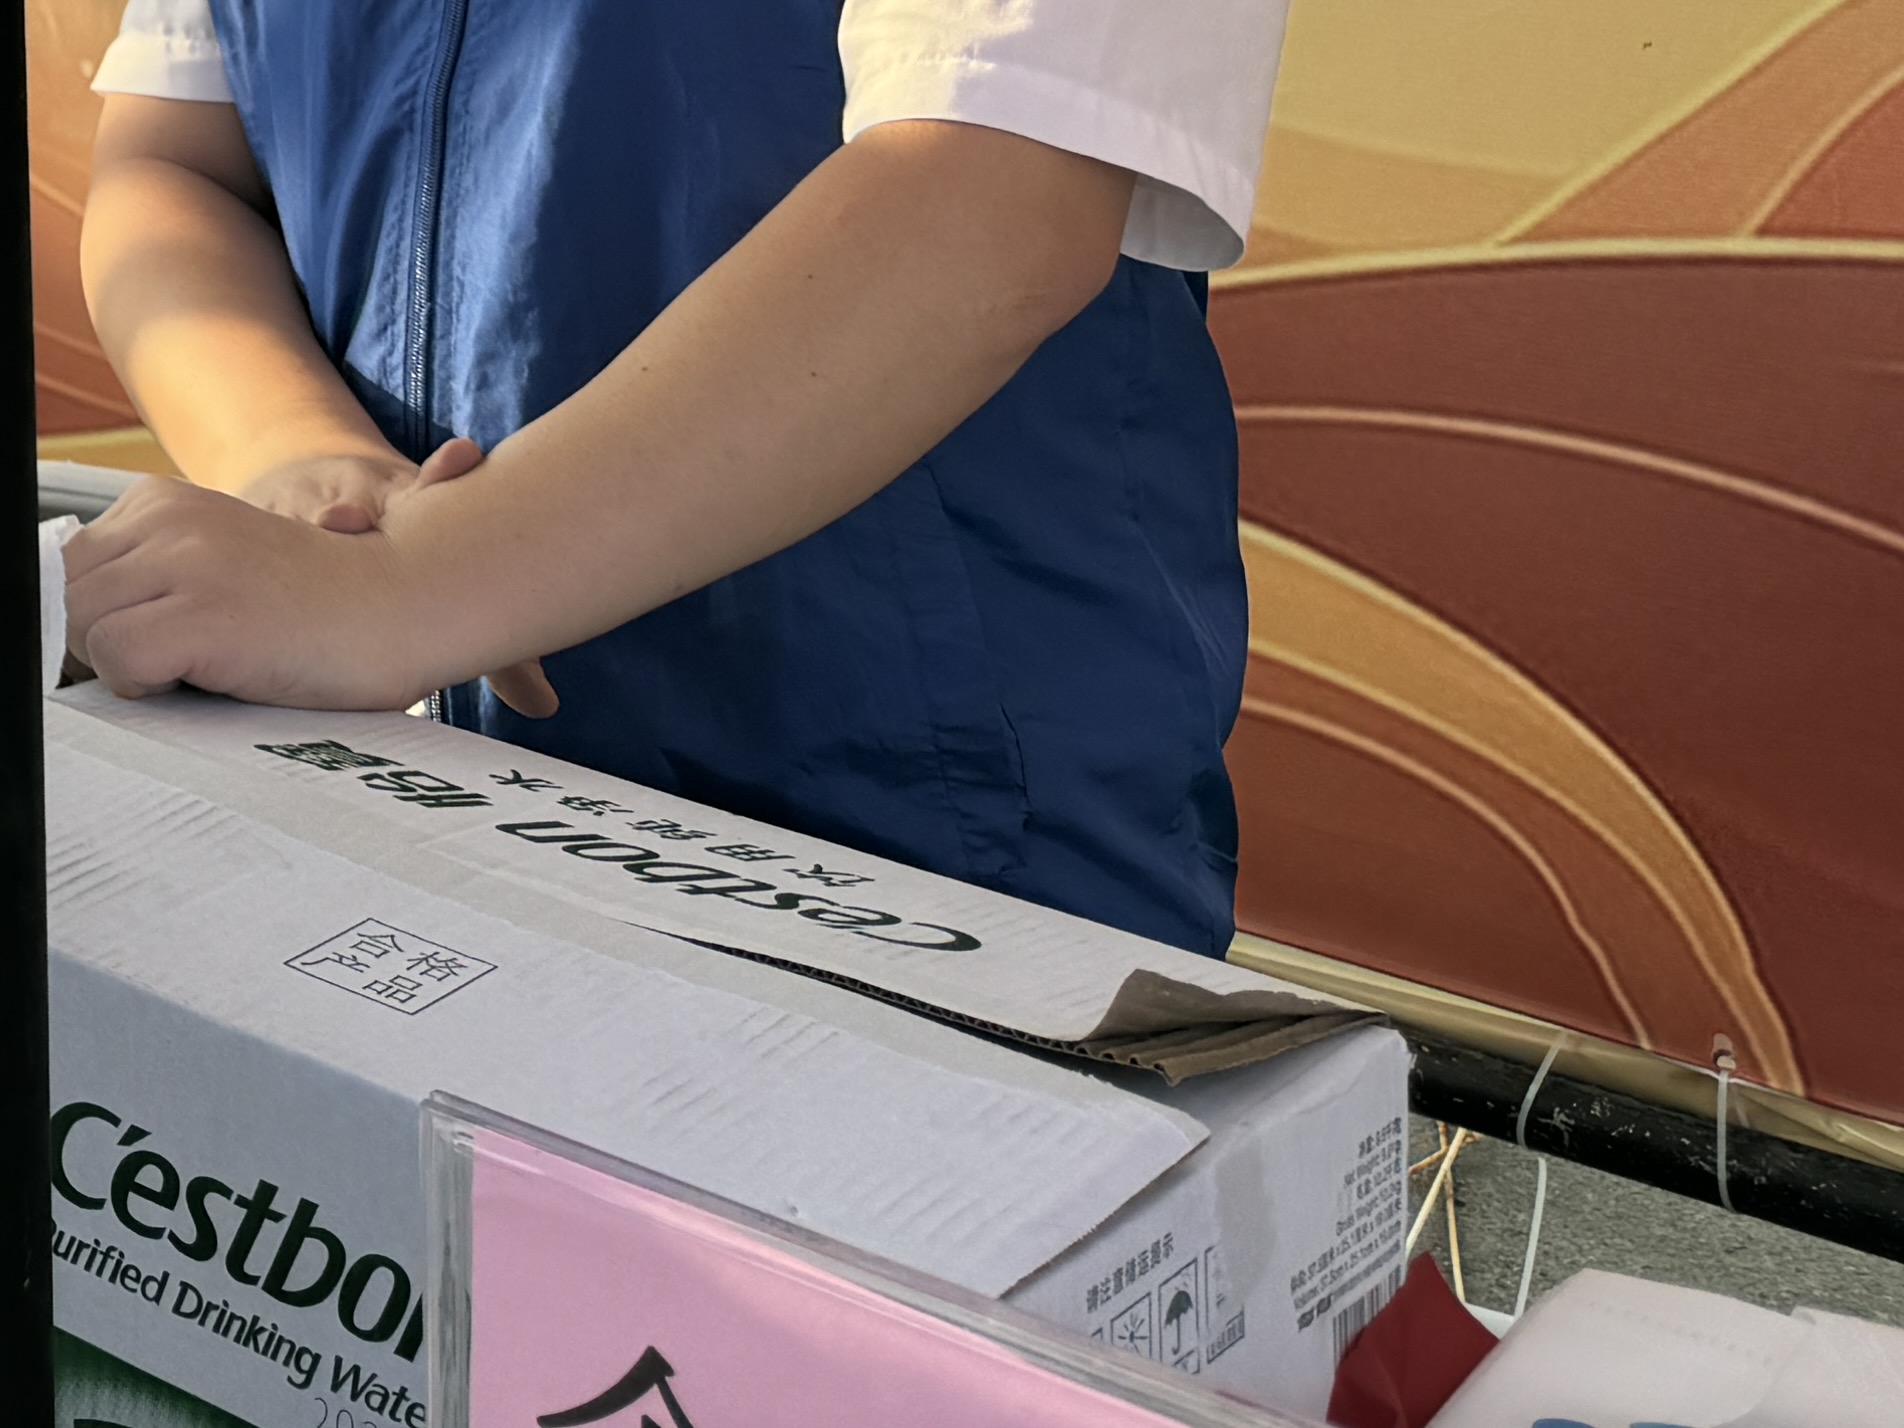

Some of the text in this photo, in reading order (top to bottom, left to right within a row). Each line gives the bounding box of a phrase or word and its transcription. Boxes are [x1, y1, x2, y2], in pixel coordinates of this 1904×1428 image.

[491, 769, 875, 888] 饮用纯净水
[300, 957, 424, 1007] 产品
[348, 930, 470, 985] 合格
[51, 1101, 423, 1363] C'estbo
[52, 1218, 170, 1305] urified
[171, 1279, 322, 1390] Drinking
